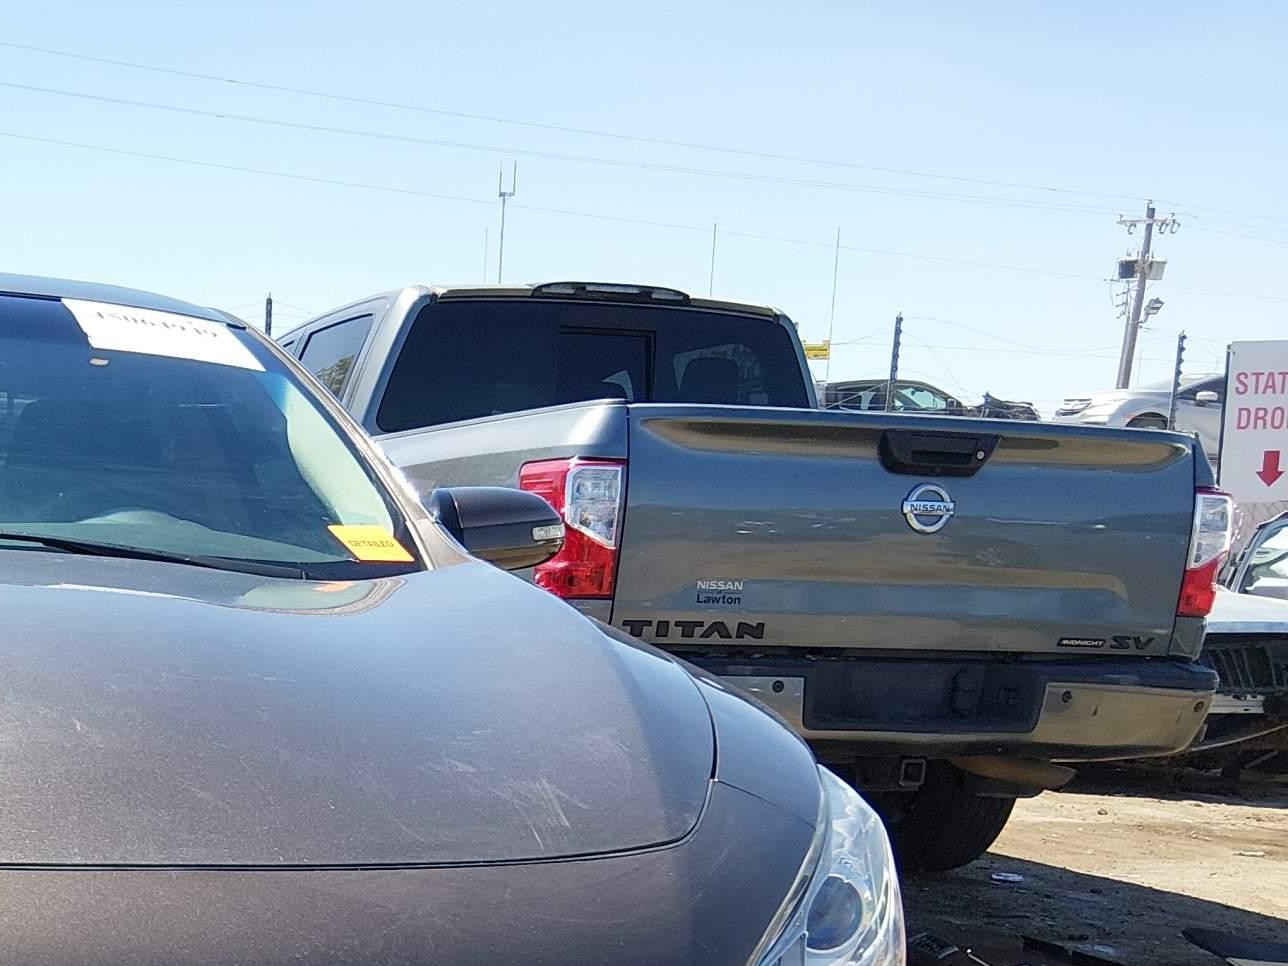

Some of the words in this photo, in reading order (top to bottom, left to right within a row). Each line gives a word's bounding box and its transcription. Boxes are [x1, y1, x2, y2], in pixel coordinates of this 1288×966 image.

[1236, 406, 1288, 430] DRO
[910, 503, 951, 512] NISSAN
[696, 580, 743, 590] NISSAN
[696, 593, 741, 604] Lawton
[622, 619, 765, 639] TITAN
[1062, 639, 1104, 647] MIDNIGHT
[1110, 635, 1155, 650] SV
